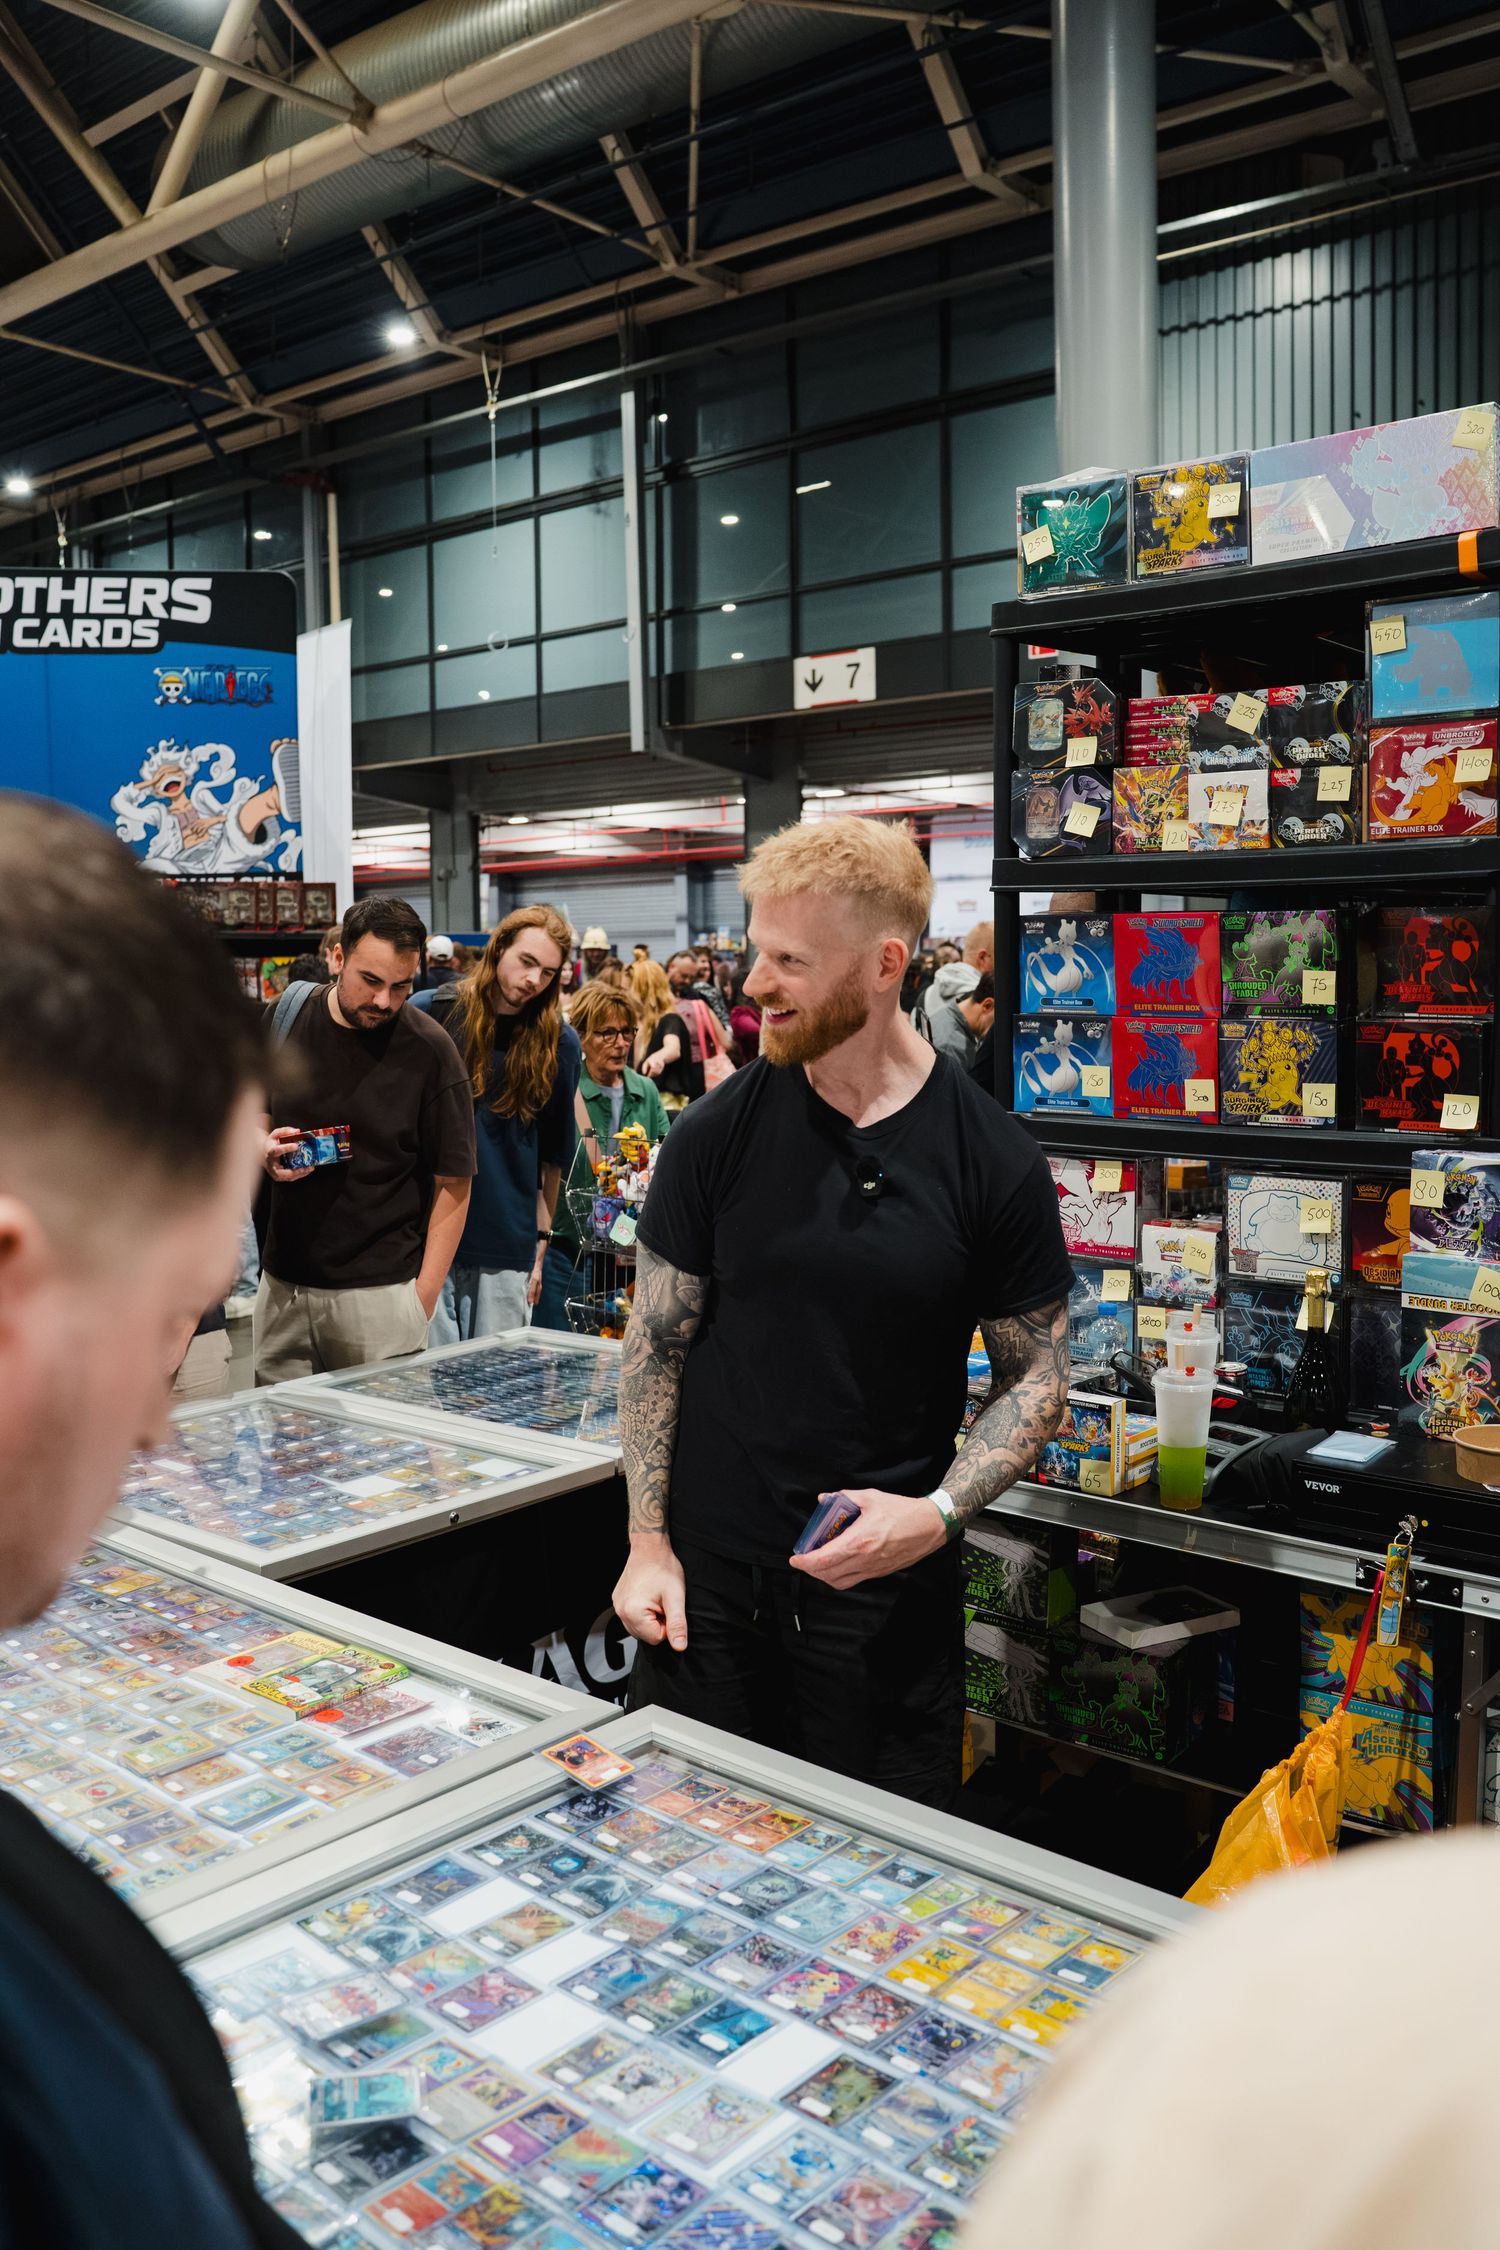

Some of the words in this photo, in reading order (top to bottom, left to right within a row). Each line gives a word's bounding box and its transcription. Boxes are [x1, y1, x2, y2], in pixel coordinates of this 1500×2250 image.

[1462, 420, 1484, 435] 320
[1215, 490, 1237, 507] 300
[1027, 534, 1048, 553] 250
[1143, 550, 1182, 562] SURGING
[1145, 556, 1184, 570] SPARKS
[12, 618, 160, 648] CARDS
[1374, 627, 1401, 643] 550
[846, 662, 860, 689] 7
[1235, 705, 1256, 719] 225
[1435, 730, 1480, 740] UNBROKEN
[1071, 748, 1088, 761] 110
[1292, 744, 1329, 753] PERFECT
[1204, 756, 1227, 765] CHAOS
[1229, 754, 1253, 763] RISING
[1461, 757, 1490, 769] 1400
[1321, 781, 1344, 793] 225
[1211, 802, 1237, 814] 275
[1070, 813, 1087, 826] 110
[1294, 827, 1329, 835] PERFECT
[1297, 832, 1327, 840] ORDER
[1370, 827, 1391, 836] ELITE
[1392, 825, 1426, 834] TRAINER
[1427, 824, 1444, 832] BOX
[1165, 831, 1187, 845] 120
[1152, 918, 1177, 928] SWORD
[1180, 918, 1205, 927] SHIELD
[1228, 982, 1267, 991] SHROUDED
[1309, 978, 1327, 995] 75
[1236, 990, 1258, 998] FABLE
[1185, 1004, 1200, 1012] BOX
[1151, 1024, 1176, 1033] SWORD
[1179, 1024, 1202, 1034] SHIELD
[1086, 1074, 1104, 1087] 150
[1309, 1092, 1328, 1107] 150
[1131, 1106, 1149, 1114] ELITE
[1150, 1108, 1181, 1116] TRAINER
[1182, 1108, 1197, 1116] BOX
[1228, 1101, 1270, 1113] SPARKS
[1446, 1102, 1472, 1116] 120
[1099, 1169, 1118, 1179] 300
[1413, 1179, 1437, 1200] 80
[1306, 1209, 1331, 1221] 500
[1436, 1237, 1476, 1251] アビスアイ
[1189, 1247, 1207, 1260] 240
[1364, 1266, 1401, 1278] OBSIDIAN
[1106, 1277, 1126, 1288] 500
[1365, 1275, 1398, 1283] FLAMES
[1408, 1295, 1447, 1310] BUNDLE
[1450, 1300, 1500, 1316] OOSTER
[1139, 1316, 1162, 1328] 3800
[1060, 1440, 1090, 1452] SPARKS
[1084, 1470, 1101, 1488] 65
[1304, 1480, 1340, 1494] VEVOR
[1371, 1709, 1398, 1719] TRAINER
[1361, 1730, 1427, 1758] ASCENDED
[1367, 1744, 1417, 1762] HEROES
